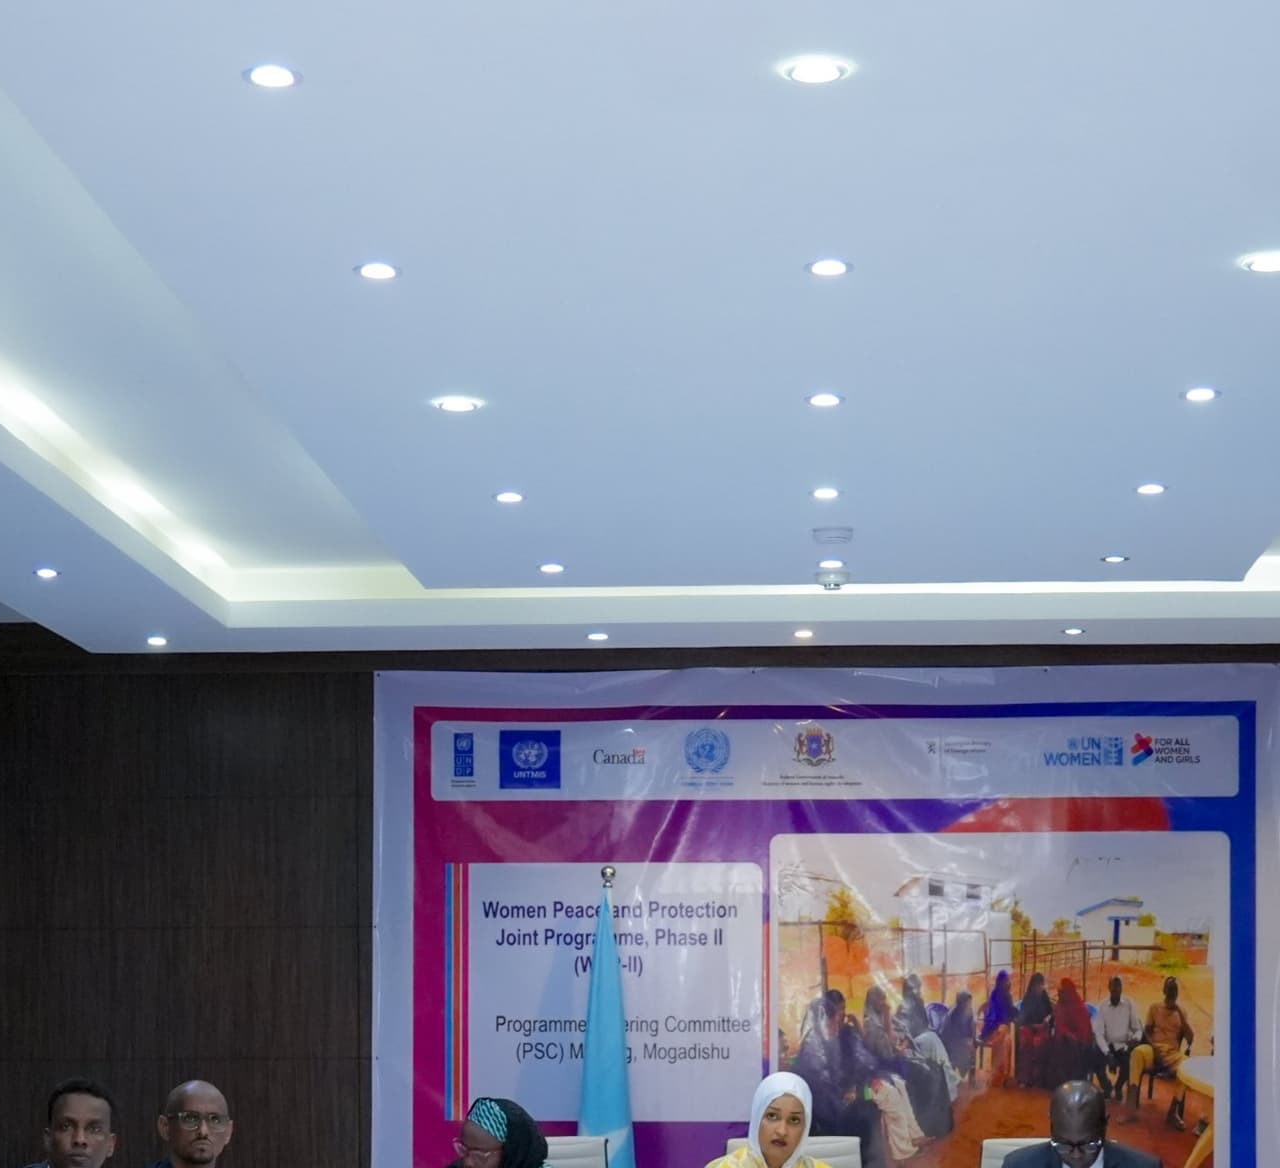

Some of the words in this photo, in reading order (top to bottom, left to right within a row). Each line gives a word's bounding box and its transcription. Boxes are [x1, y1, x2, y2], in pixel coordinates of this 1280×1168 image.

[1081, 736, 1101, 750] UN
[1154, 738, 1173, 746] FOR
[1174, 738, 1191, 746] ALL
[593, 749, 645, 765] Canada
[1154, 747, 1191, 755] WOMEN
[1043, 752, 1101, 767] WOMEN
[1154, 756, 1174, 764] AND
[1175, 756, 1200, 764] GIRLS
[513, 771, 547, 779] UNTMIS
[482, 901, 548, 919] Women
[612, 902, 643, 919] and
[648, 900, 738, 919] Protection
[495, 928, 539, 947] Joint
[544, 929, 649, 950] Progrme,
[655, 929, 708, 947] Phase
[713, 928, 724, 947] II
[574, 955, 644, 977] (W-II)
[495, 1016, 588, 1037] Programme
[665, 1016, 751, 1034] Committee
[516, 1042, 565, 1065] (PSC)
[643, 1043, 730, 1064] Mogadishu
